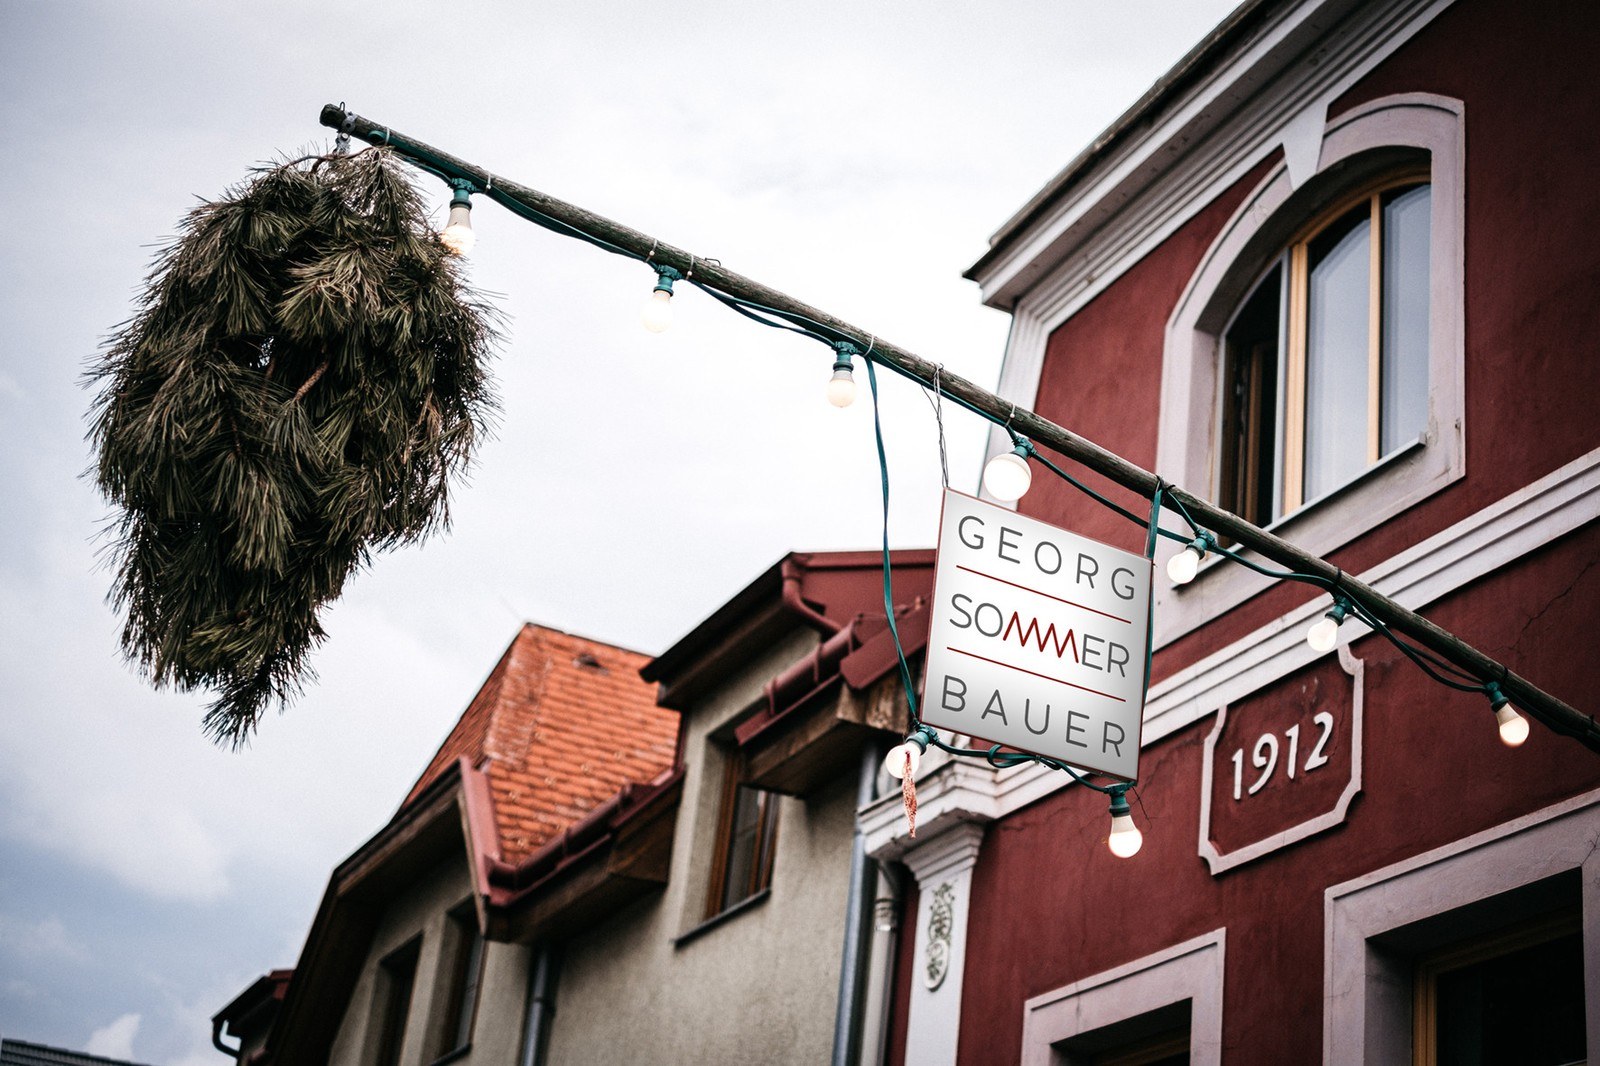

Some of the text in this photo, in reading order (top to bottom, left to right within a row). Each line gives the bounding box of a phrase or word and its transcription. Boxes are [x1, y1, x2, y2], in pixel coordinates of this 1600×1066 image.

[958, 515, 1135, 600] GEORG
[949, 593, 1130, 678] SOMMER
[941, 675, 1126, 758] BAUER
[1231, 711, 1334, 800] 1912
